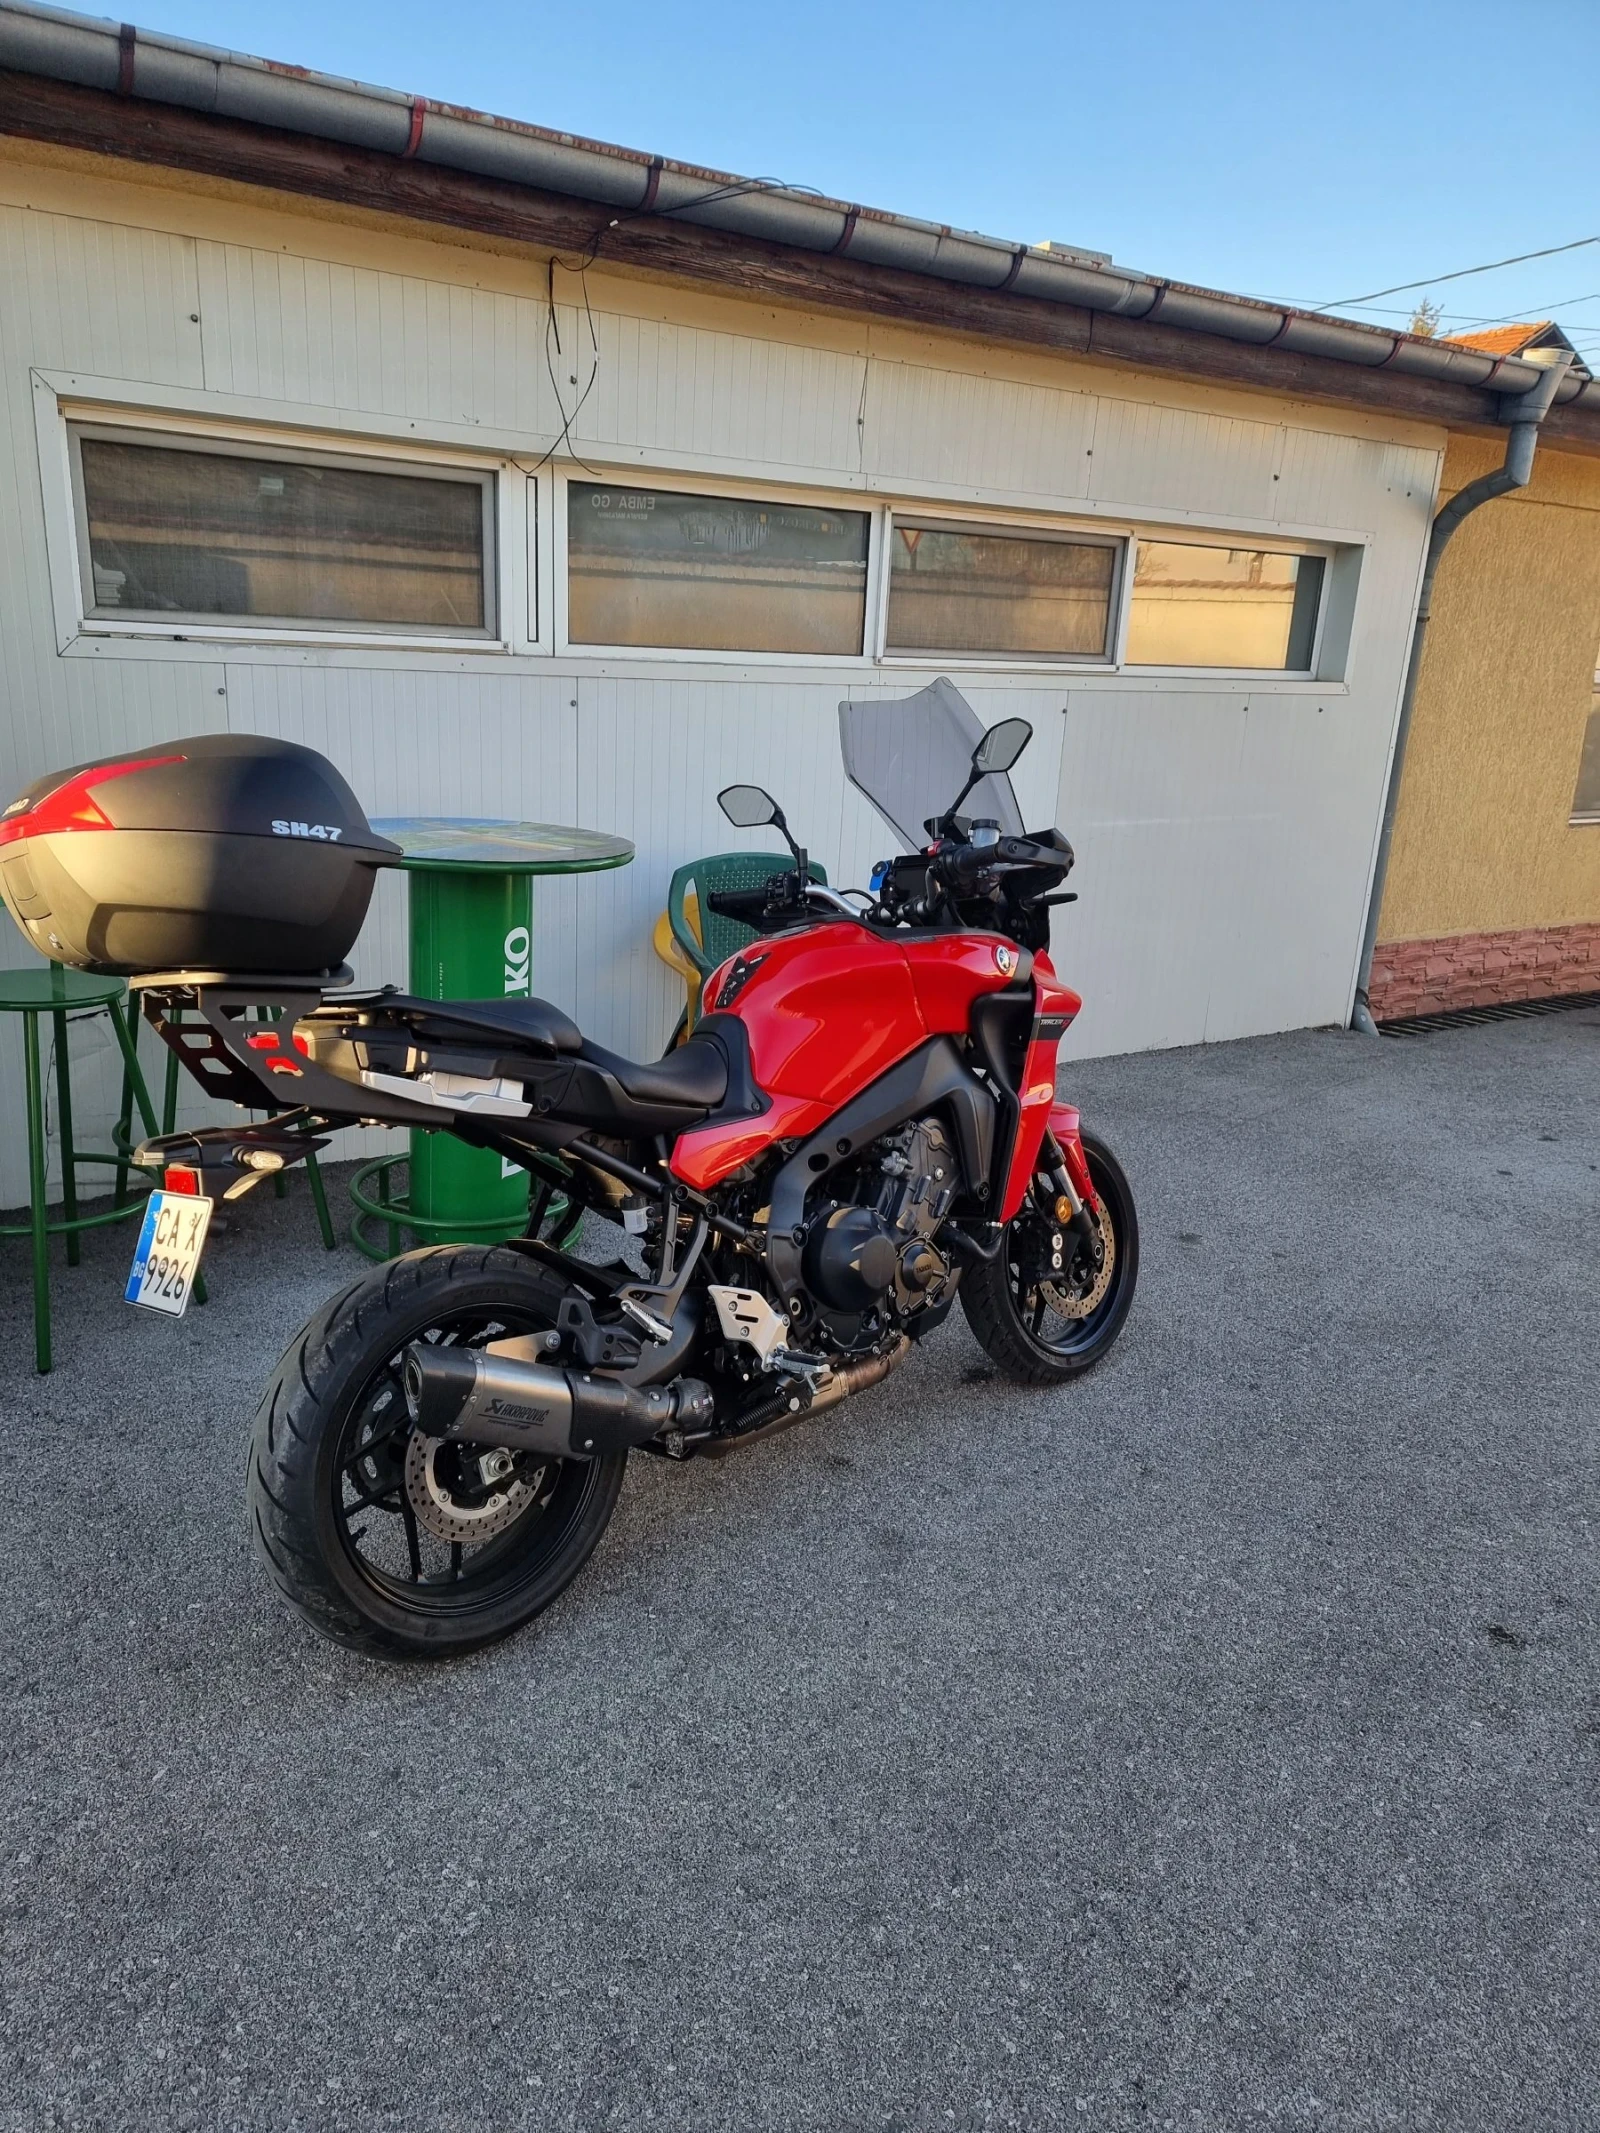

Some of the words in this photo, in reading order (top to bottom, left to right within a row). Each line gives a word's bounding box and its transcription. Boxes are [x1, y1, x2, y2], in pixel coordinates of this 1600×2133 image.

[271, 819, 342, 841] SH47
[155, 1207, 181, 1249] CA
[185, 1212, 203, 1252] X
[132, 1260, 145, 1278] BG
[143, 1253, 189, 1299] 9926
